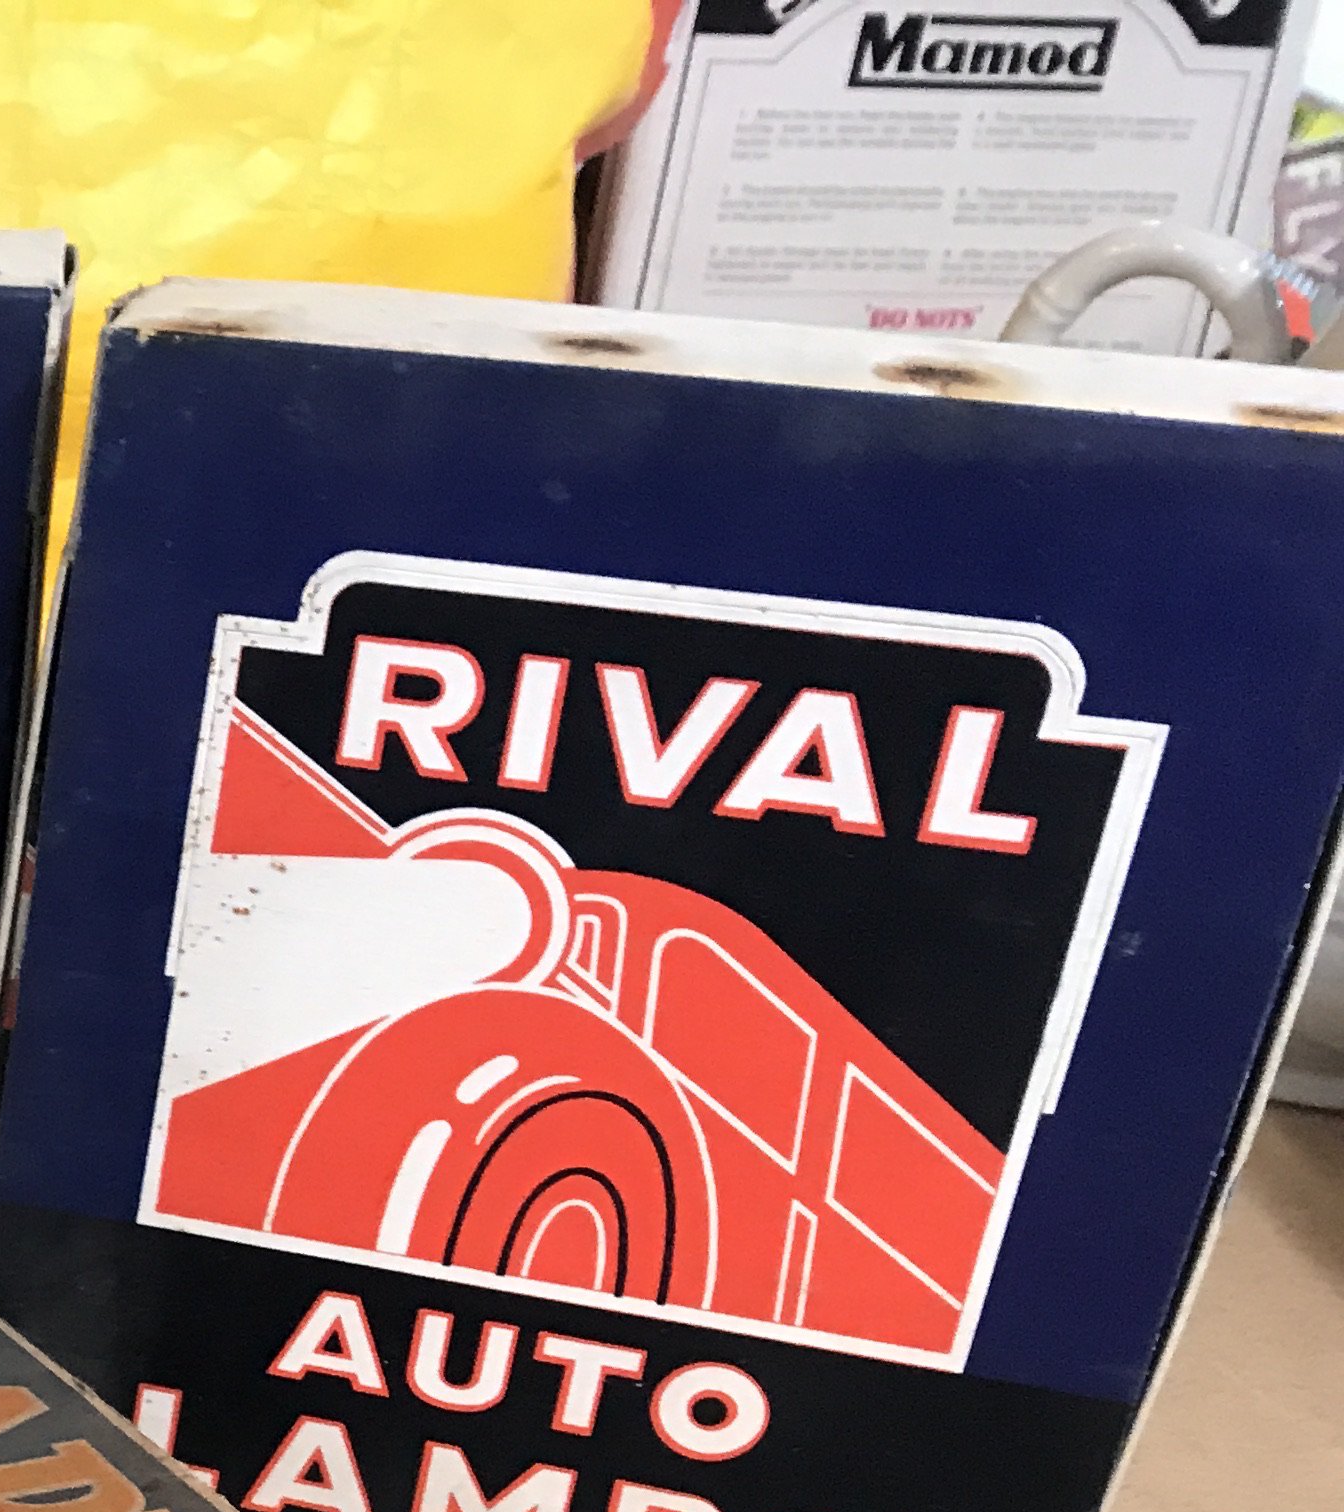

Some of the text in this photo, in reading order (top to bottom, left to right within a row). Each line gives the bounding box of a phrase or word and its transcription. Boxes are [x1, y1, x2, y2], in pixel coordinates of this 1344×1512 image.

[850, 12, 1120, 88] Mamod
[335, 634, 1036, 855] RIVAL
[266, 1291, 769, 1461] AUTO
